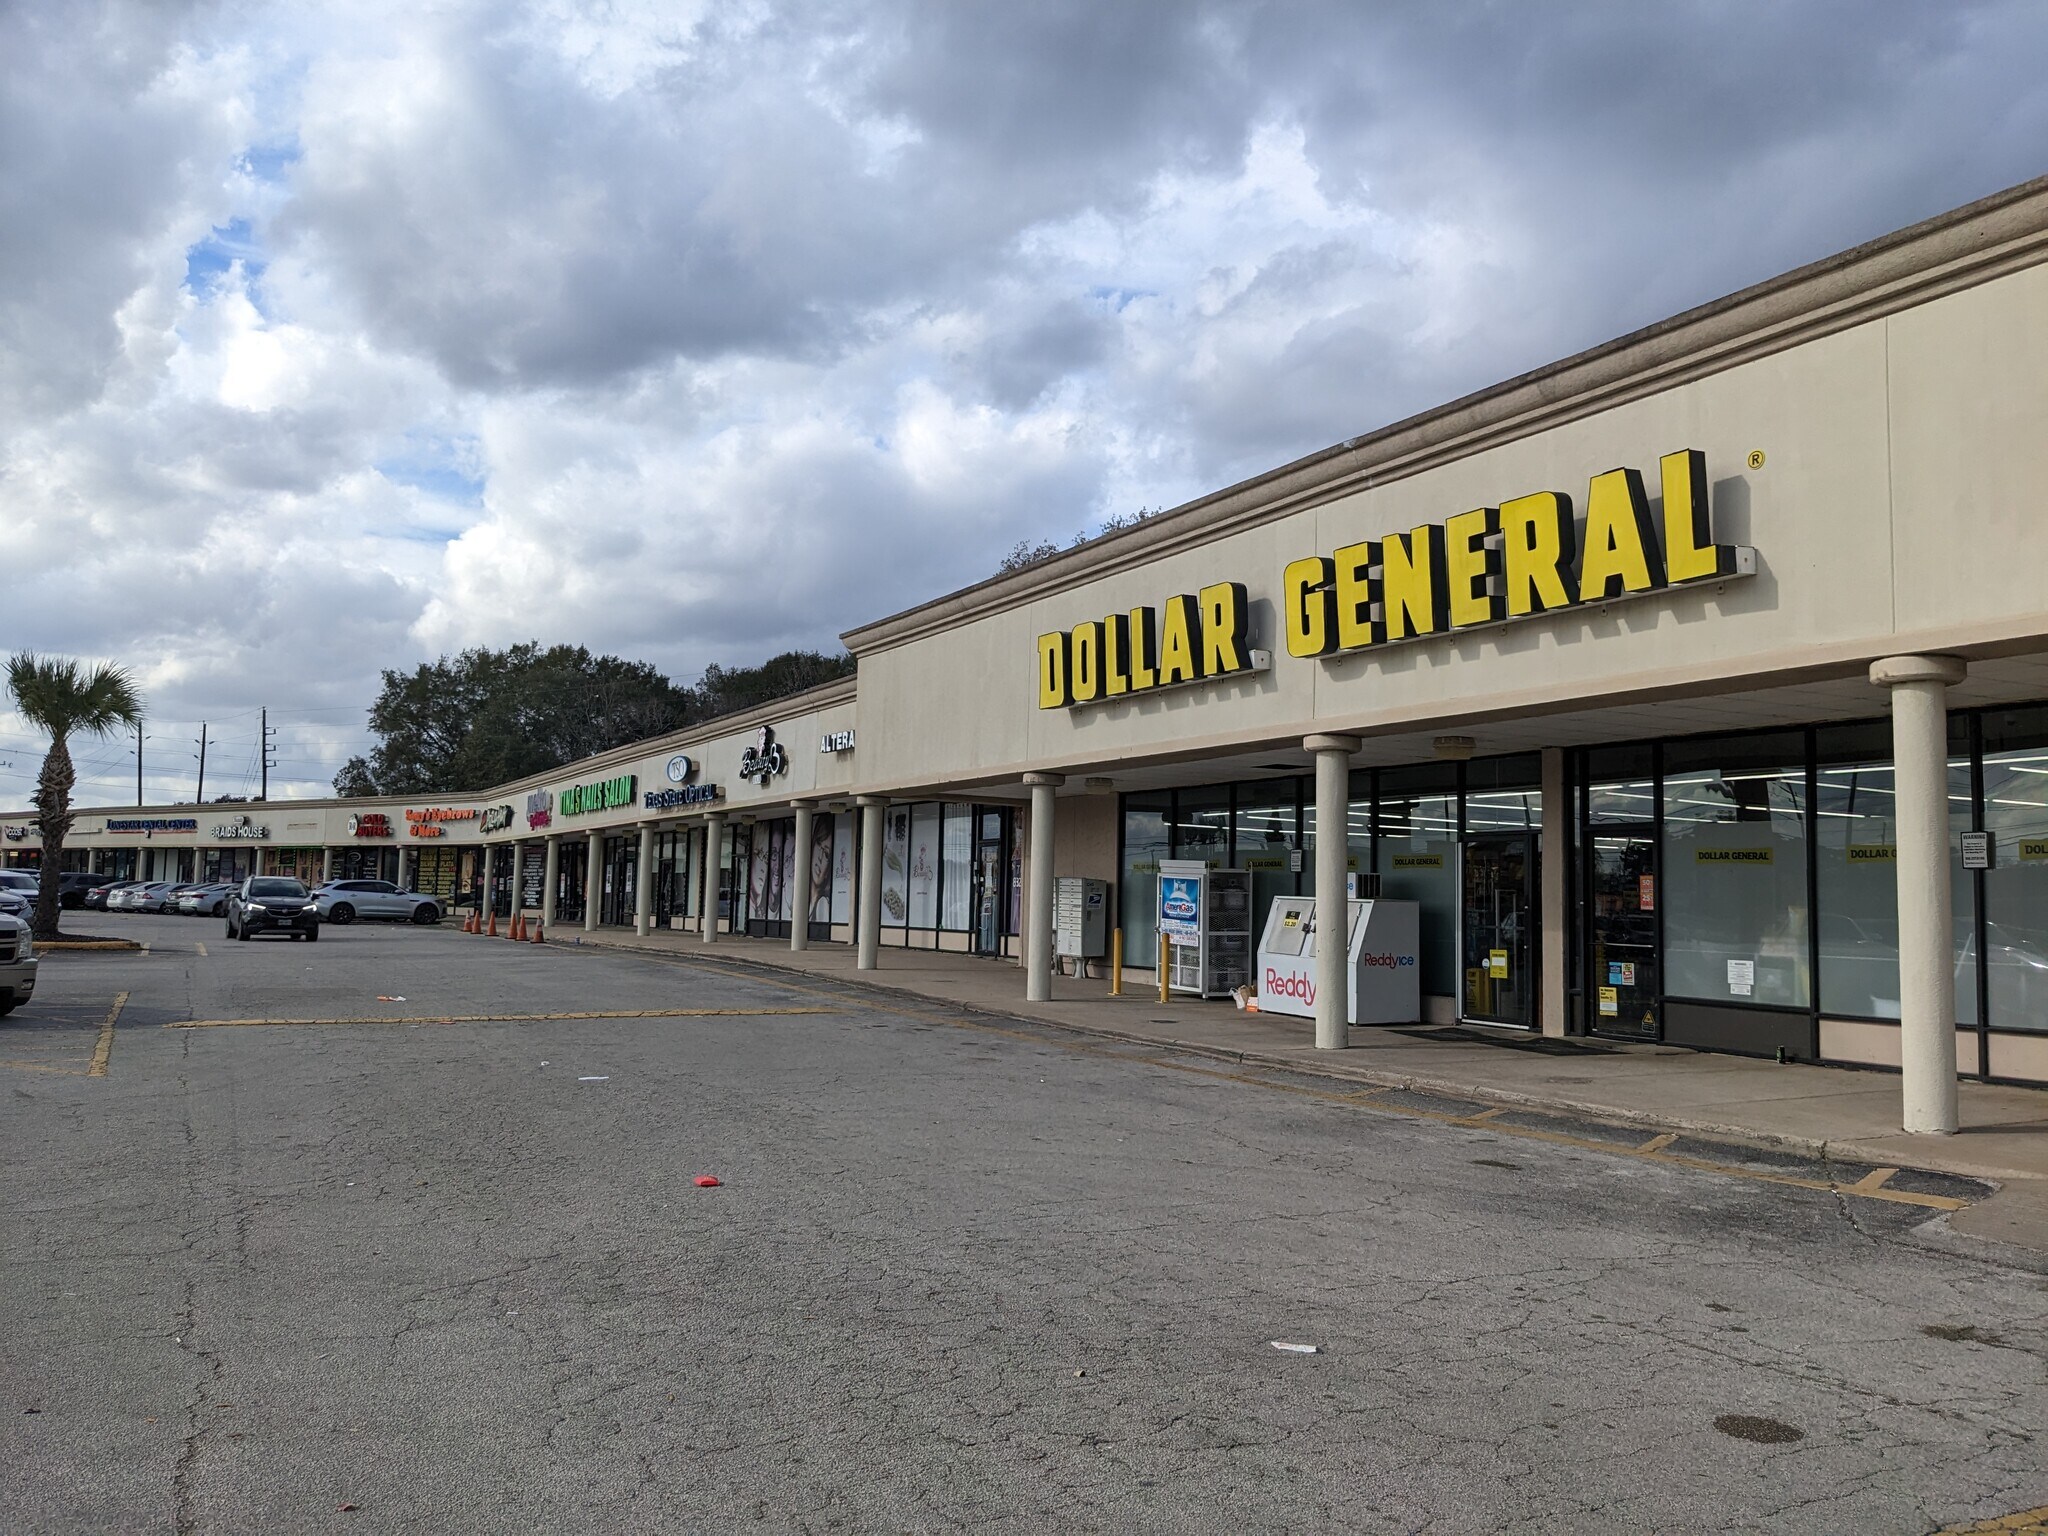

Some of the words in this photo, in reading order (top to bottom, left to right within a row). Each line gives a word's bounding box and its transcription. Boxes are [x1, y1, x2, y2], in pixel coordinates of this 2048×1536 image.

[1038, 581, 1250, 710] DOLLAR
[1284, 448, 1717, 659] GENERAL
[604, 775, 632, 808] SALON
[644, 791, 664, 809] TEXAS
[664, 787, 685, 806] STATE
[685, 783, 714, 804] OPTICAL
[168, 819, 197, 830] CENTER
[362, 813, 384, 825] GOLD
[211, 826, 237, 838] BRAIDS
[238, 826, 263, 838] HOUSE
[357, 825, 388, 837] BUYERS
[1698, 851, 1730, 860] DOLLAR
[1732, 852, 1769, 860] GENERAL
[1851, 849, 1889, 858] DOLLAR
[1395, 858, 1414, 866] DOLLAR
[1416, 857, 1440, 865] GENERAL
